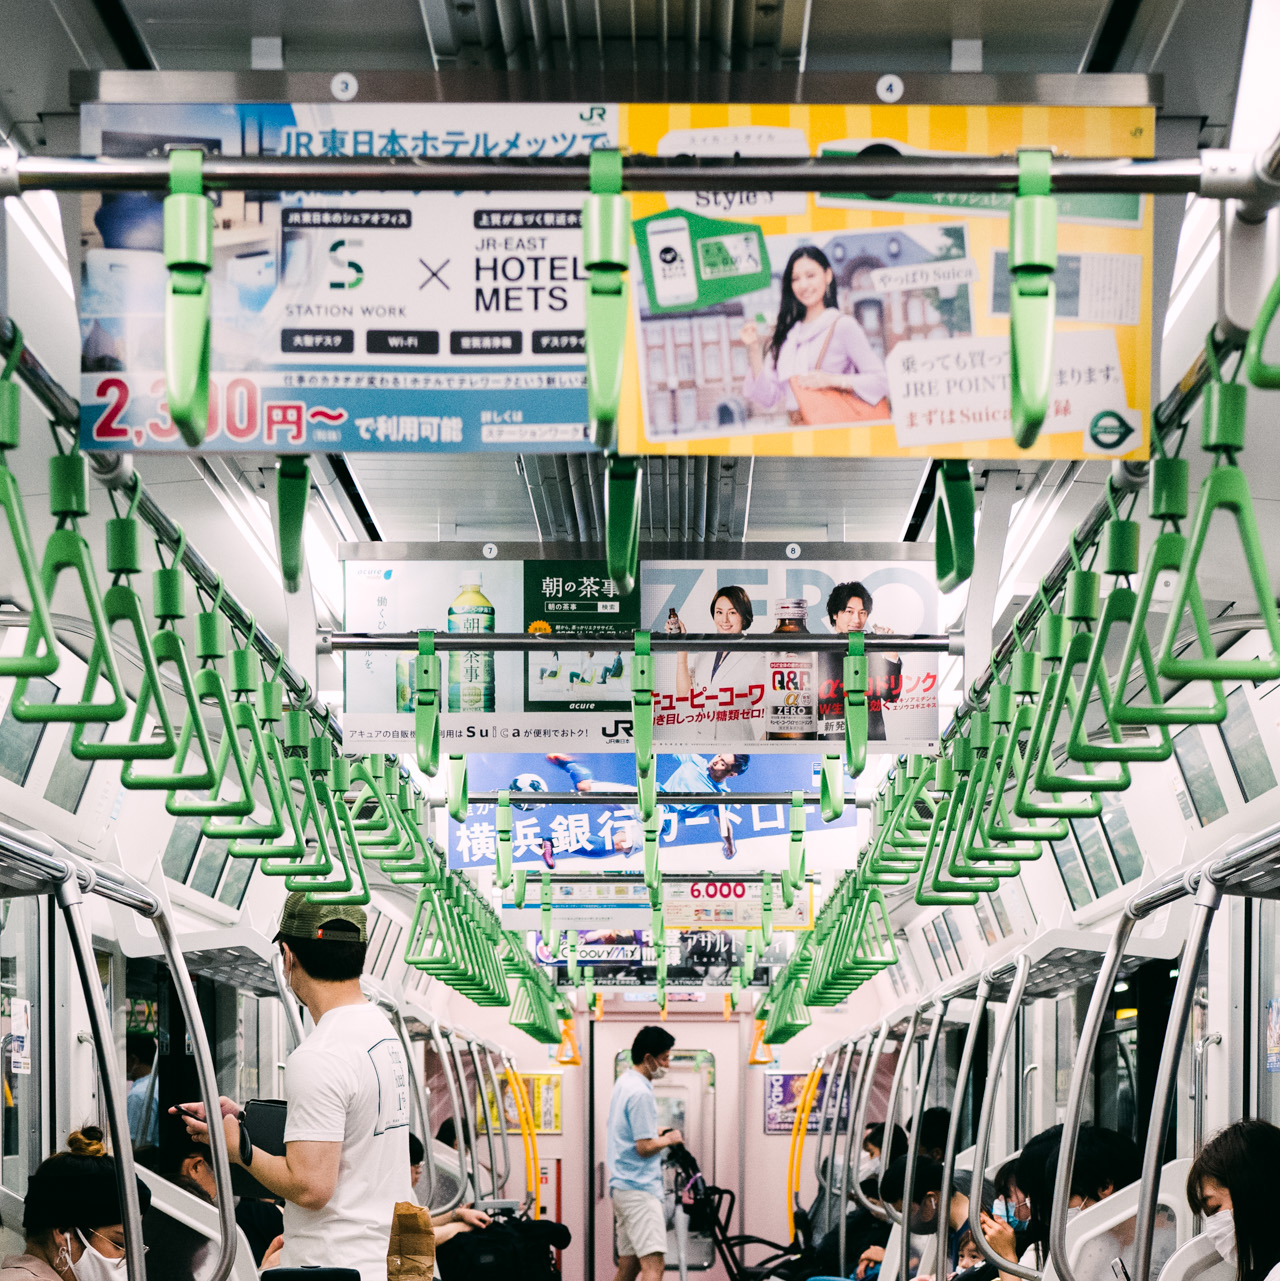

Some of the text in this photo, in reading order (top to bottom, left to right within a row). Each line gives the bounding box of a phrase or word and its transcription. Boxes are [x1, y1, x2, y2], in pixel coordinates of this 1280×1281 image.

[886, 82, 895, 95] 4
[578, 106, 607, 122] JR
[475, 236, 548, 251] JR-EAST
[475, 286, 569, 312] METS
[286, 304, 407, 317] STATION WORK
[387, 335, 419, 348] Wi-Fi
[903, 378, 940, 398] JRE
[354, 415, 464, 443] で利用可能
[790, 547, 796, 555] 8
[541, 576, 620, 598] 朝の茶事
[547, 603, 577, 611] 朝の茶事
[642, 567, 938, 635] ZERO
[818, 672, 937, 699] αドリンク
[569, 702, 595, 710] acure
[777, 706, 806, 715] ZERO
[466, 726, 521, 738] Suica
[602, 720, 634, 738] JR
[731, 954, 774, 962] Bulet
